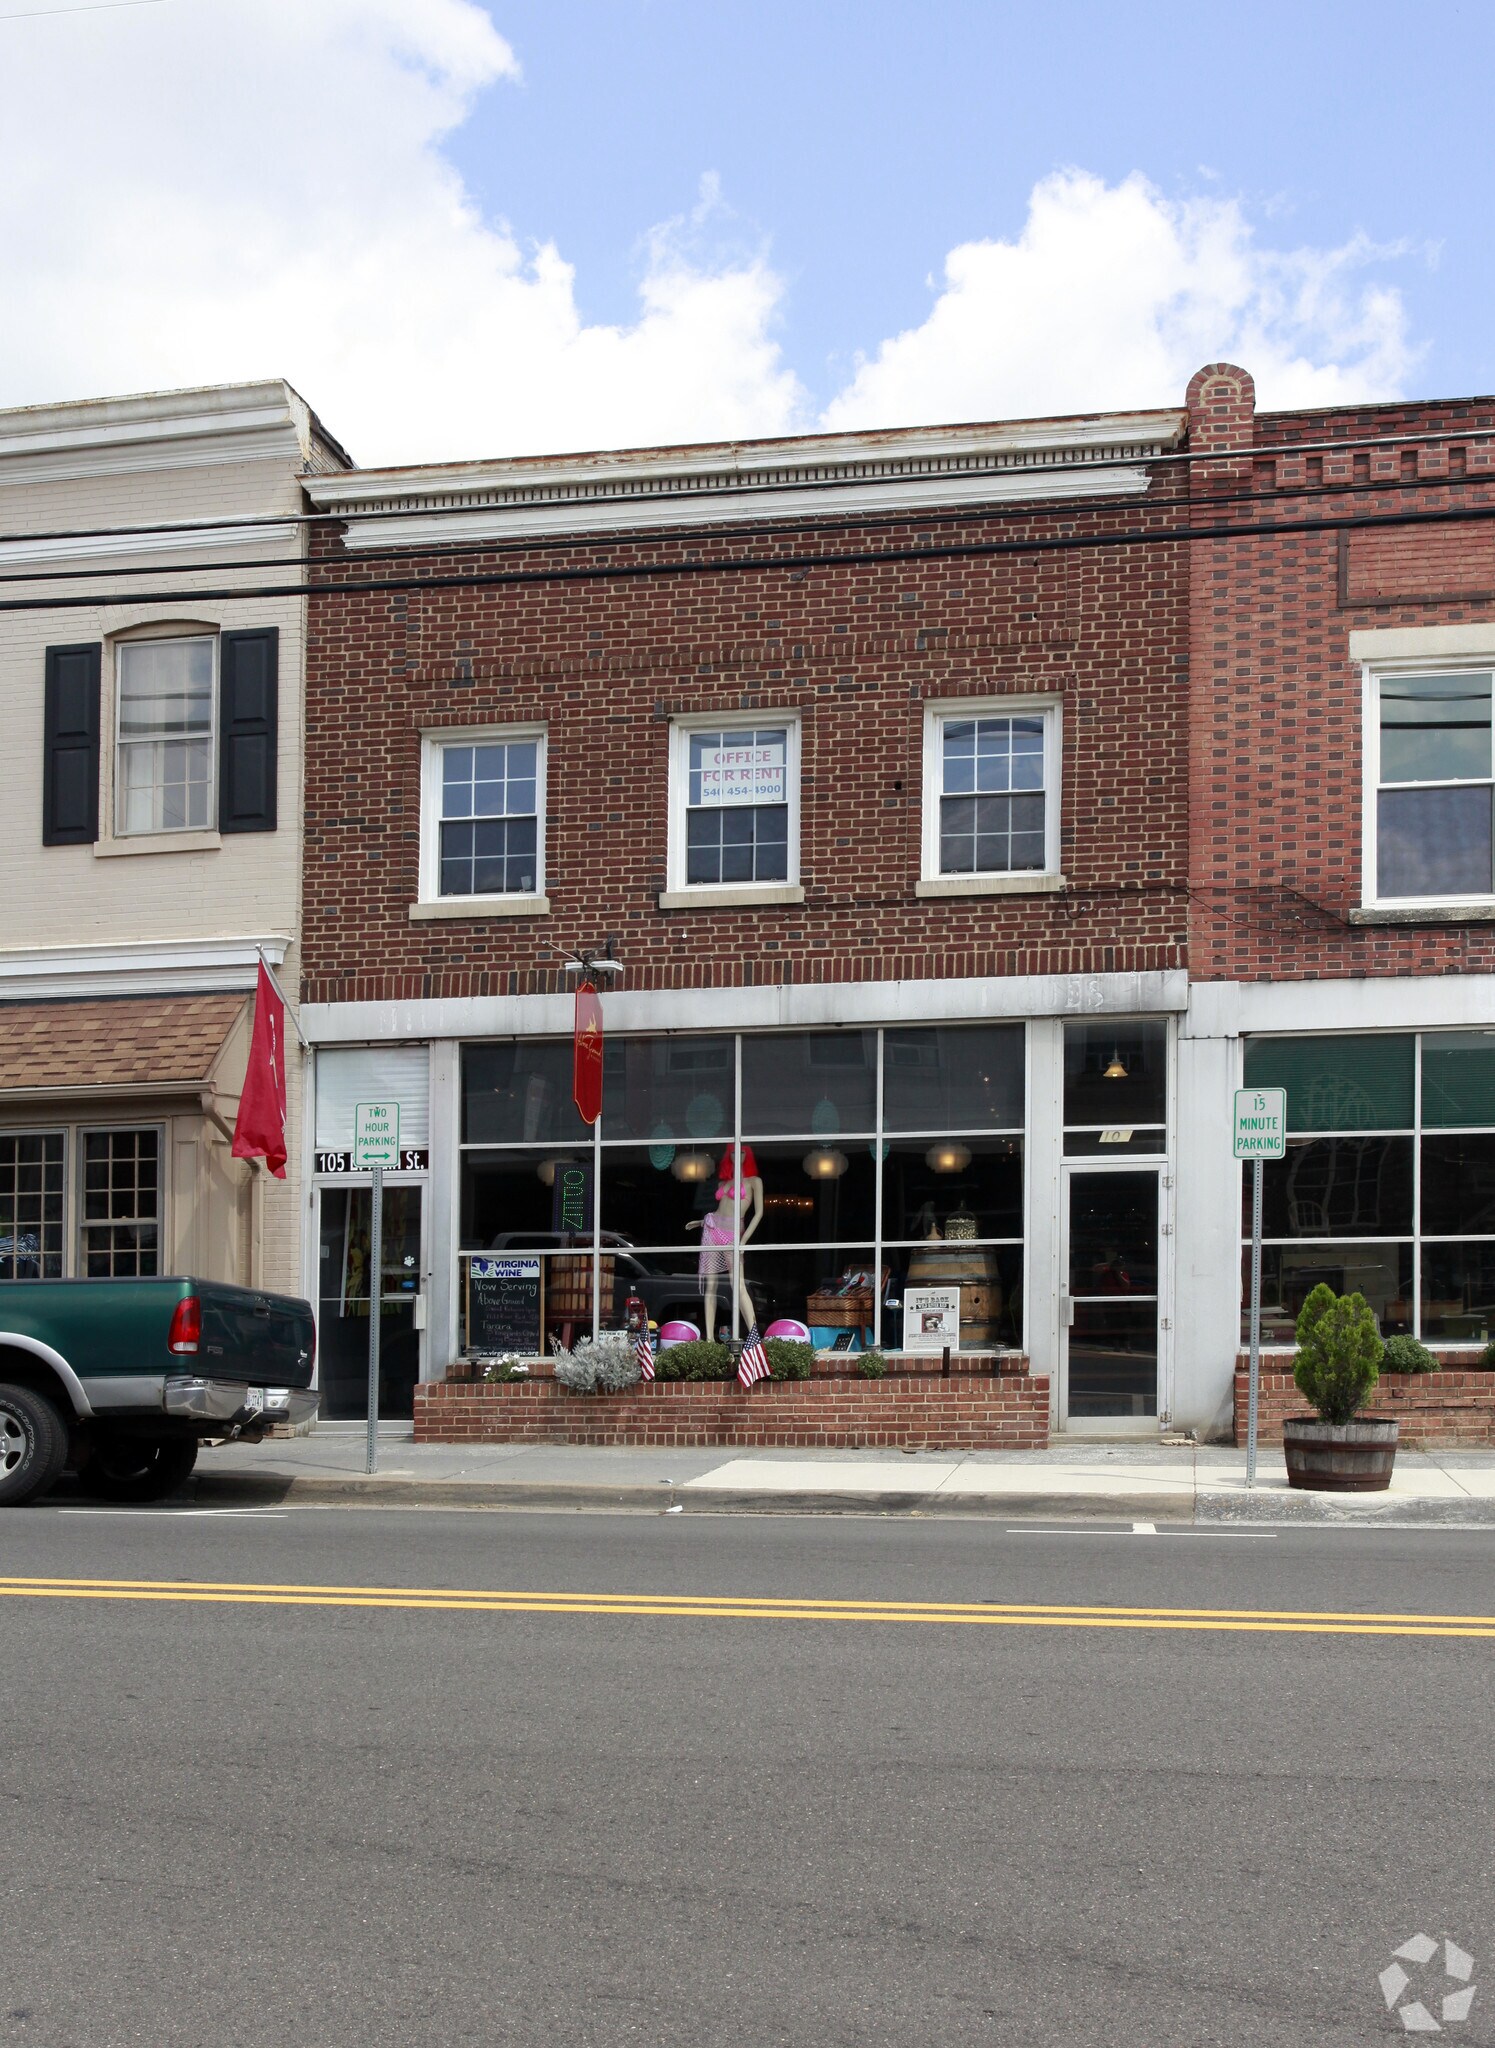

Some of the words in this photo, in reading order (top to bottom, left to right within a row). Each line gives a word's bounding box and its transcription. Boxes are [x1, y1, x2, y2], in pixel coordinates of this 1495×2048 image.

[714, 750, 771, 764] OFFICE
[703, 769, 735, 782] FOR
[740, 767, 780, 780] RENT
[703, 787, 724, 797] 540
[726, 784, 781, 796] 454-4900
[1254, 1097, 1266, 1111] 15
[369, 1107, 387, 1118] TWO
[365, 1122, 389, 1132] HOUR
[1239, 1117, 1279, 1130] MINUTE
[358, 1136, 396, 1146] PARKING
[1237, 1136, 1281, 1150] PARKING
[319, 1153, 345, 1172] 105
[405, 1151, 425, 1170] St.
[494, 1260, 539, 1268] VIRGINIA
[494, 1269, 522, 1277] WINE
[474, 1279, 497, 1291] Now
[500, 1278, 538, 1297] Serving
[477, 1293, 501, 1306] Above
